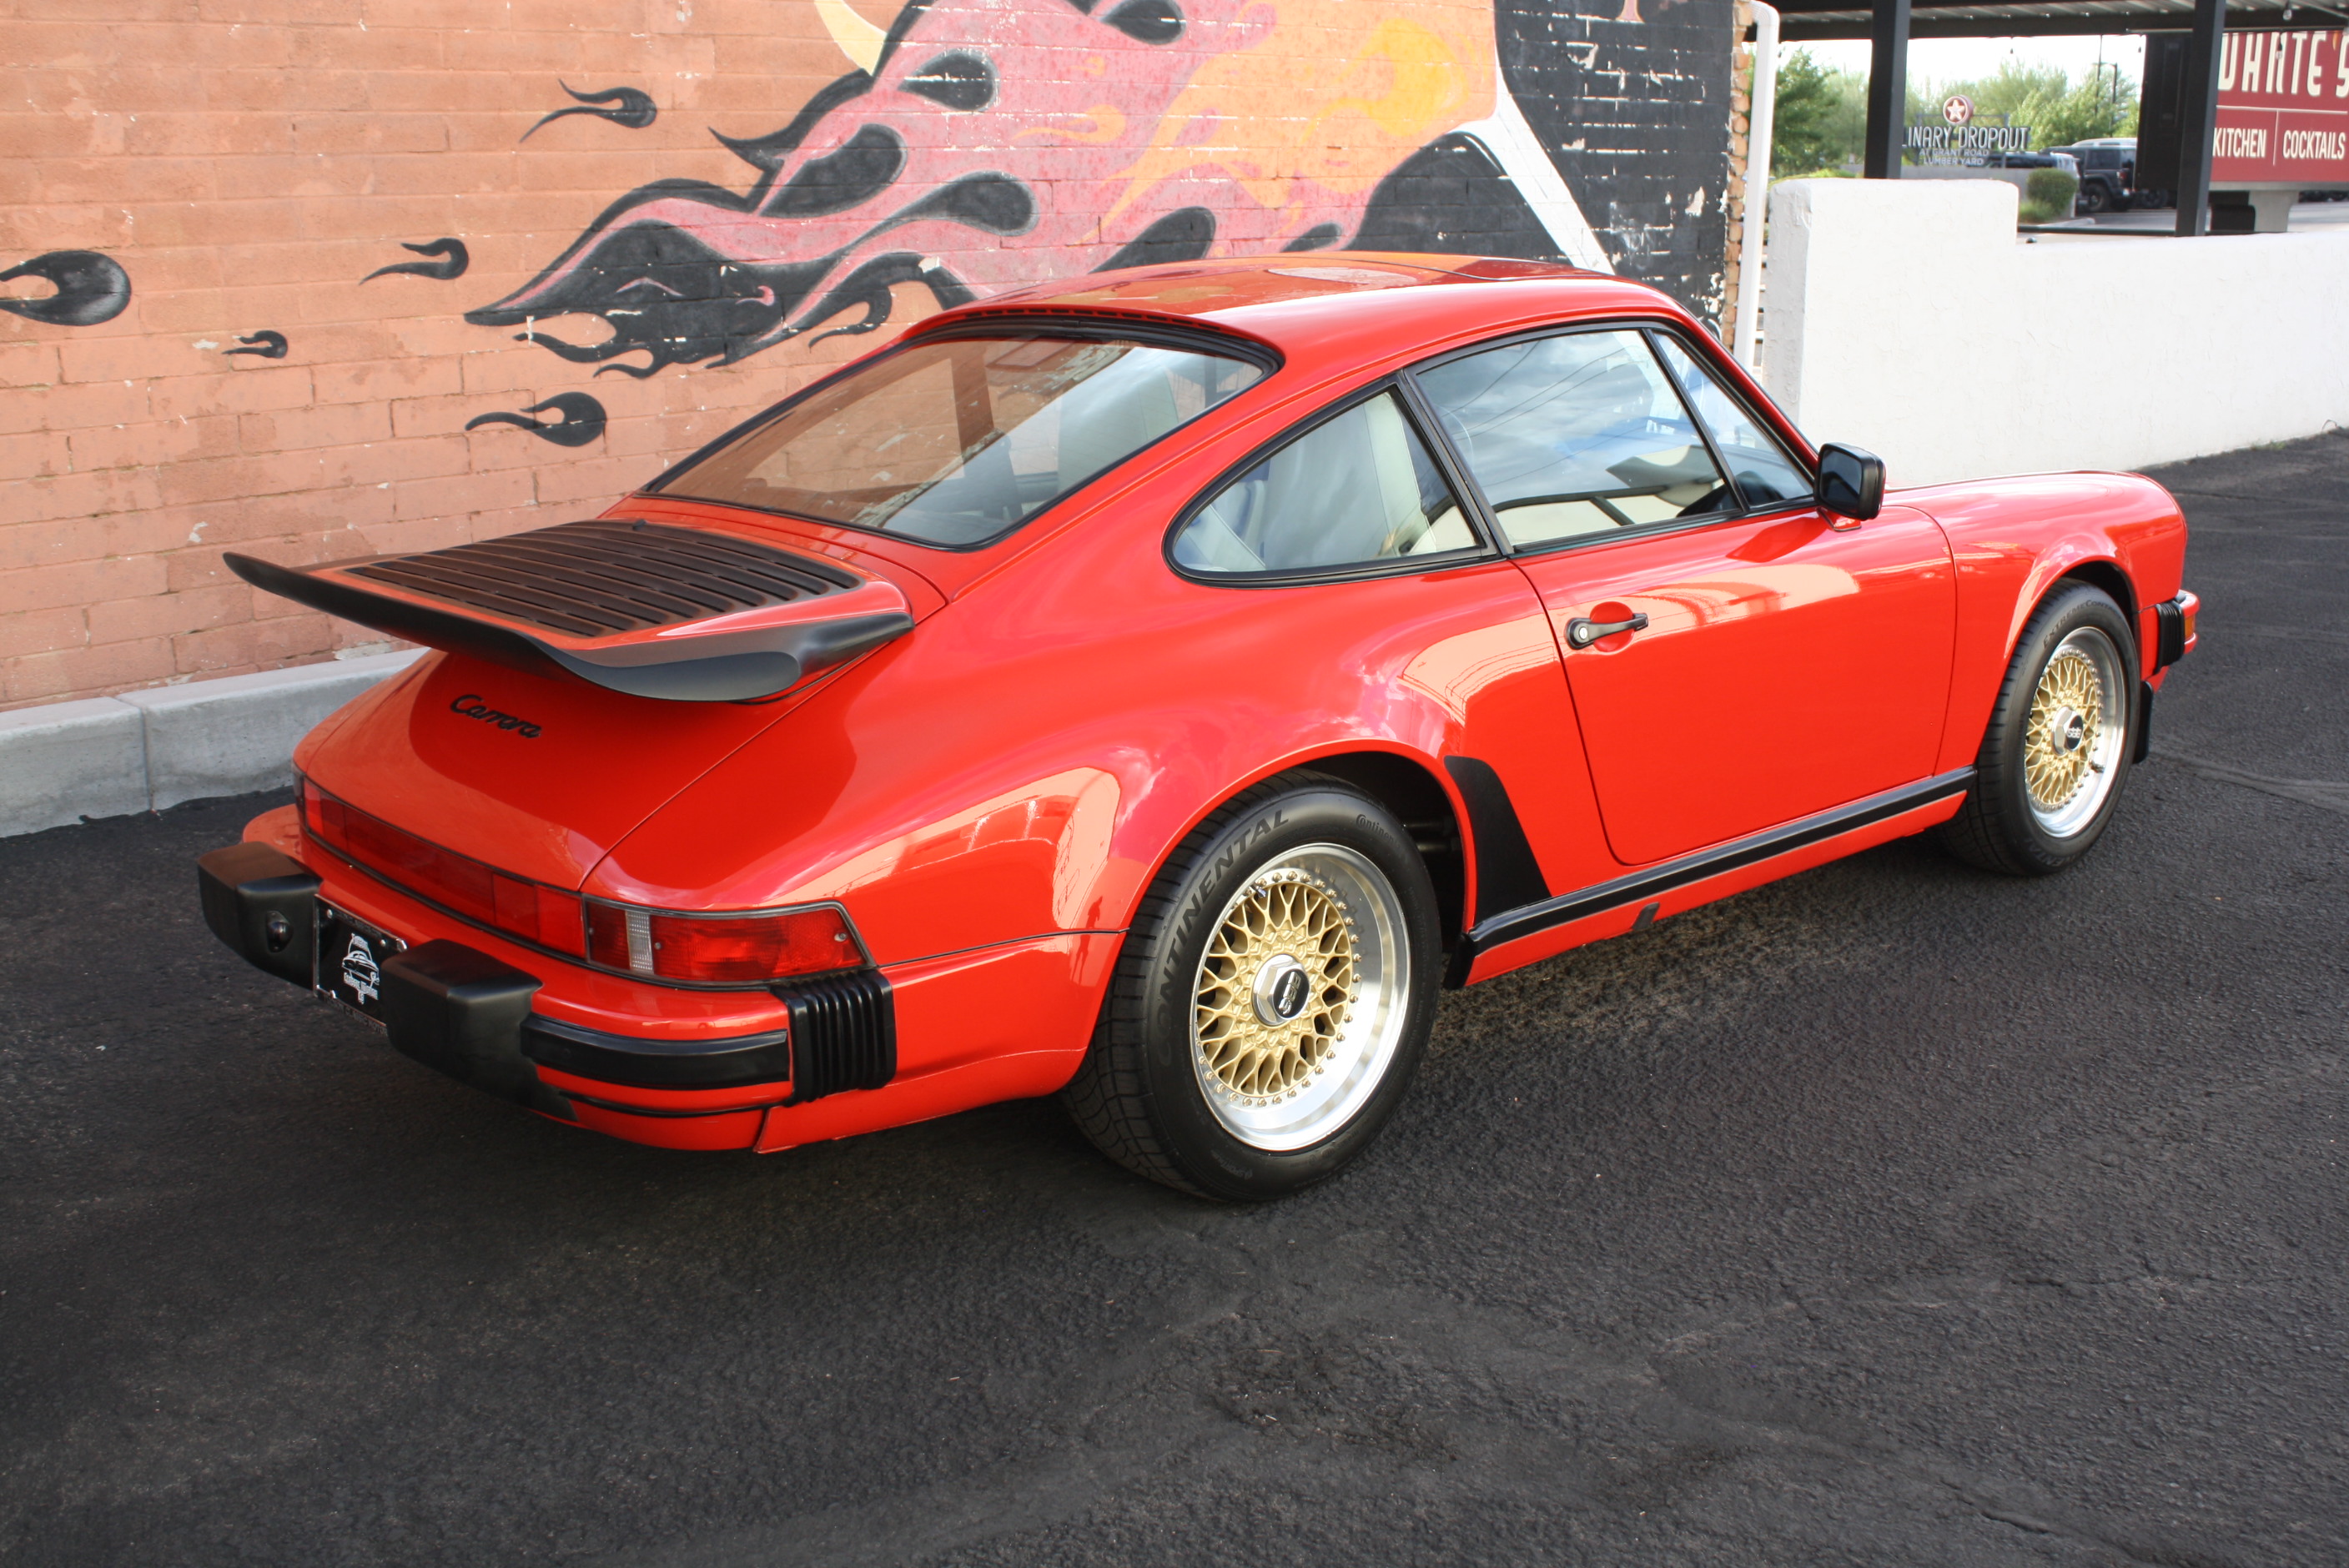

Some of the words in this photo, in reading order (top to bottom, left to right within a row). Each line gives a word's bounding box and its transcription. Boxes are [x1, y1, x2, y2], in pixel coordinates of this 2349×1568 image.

[1903, 127, 1953, 148] INARY
[1958, 126, 2030, 149] DROPOUT
[1964, 148, 1989, 157] ROAD
[2212, 128, 2267, 158] KITCHEN
[2282, 130, 2346, 160] COCKTAILS
[1924, 157, 1957, 165] LUMBER
[1960, 157, 1984, 165] YARD
[450, 694, 542, 738] Carrera
[1278, 971, 1301, 1015] BBS
